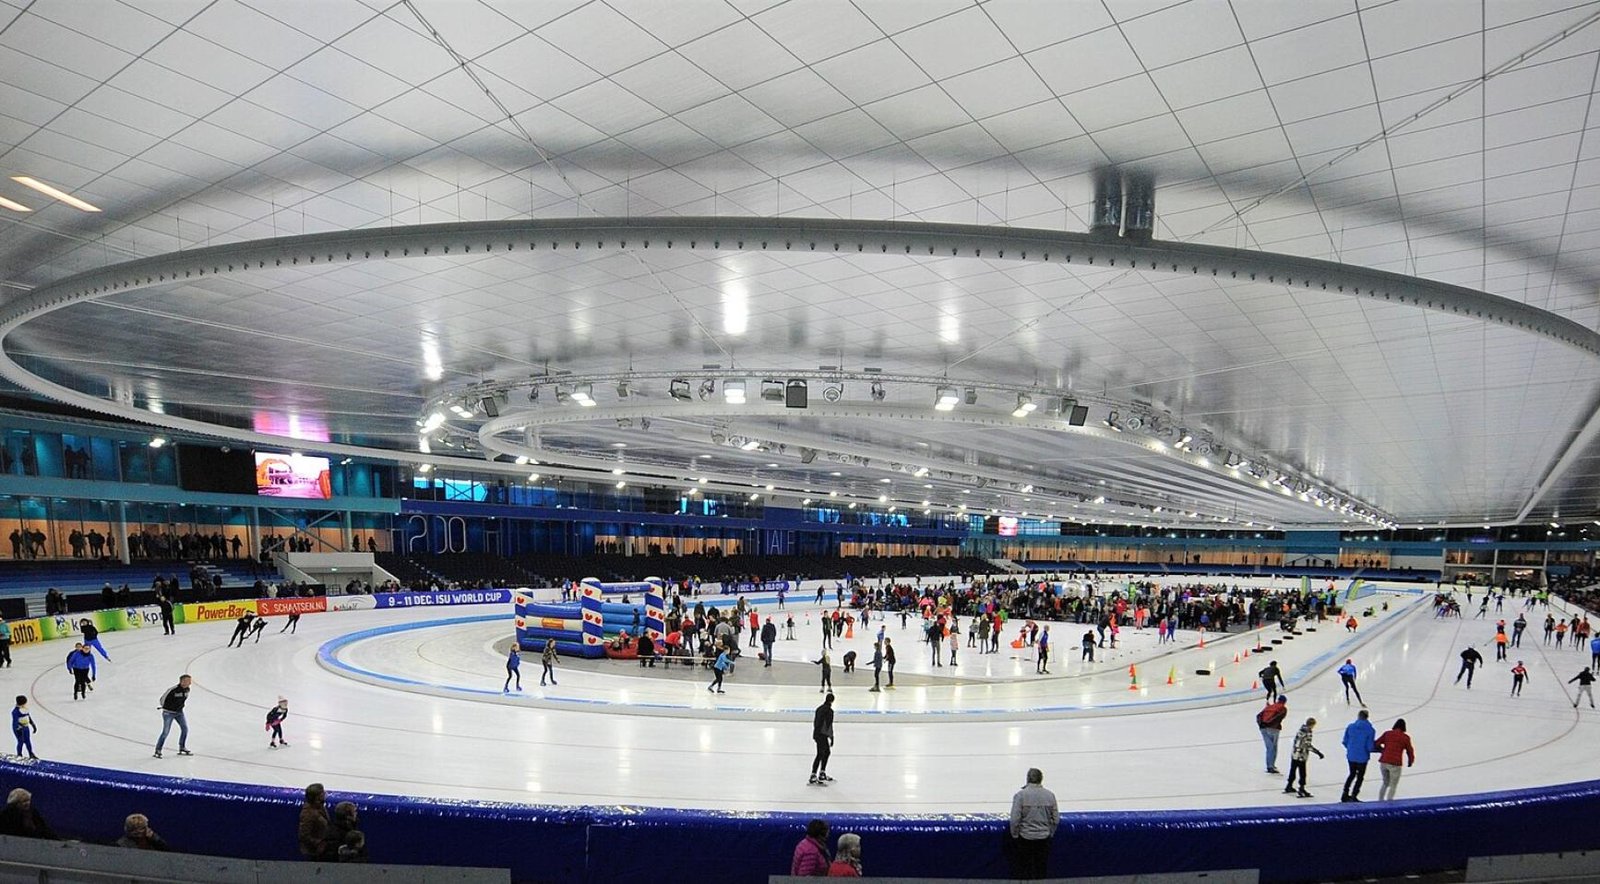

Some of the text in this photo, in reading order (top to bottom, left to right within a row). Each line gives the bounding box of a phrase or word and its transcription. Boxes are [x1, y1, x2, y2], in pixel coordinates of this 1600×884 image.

[388, 596, 395, 606] 9
[404, 596, 412, 606] 11
[414, 595, 434, 605] DEC.
[435, 595, 451, 604] ISU
[452, 593, 484, 604] WORLD
[485, 593, 502, 602] CUP
[197, 604, 245, 620] PowerBar
[273, 600, 326, 613] SCHAATSEN.NL
